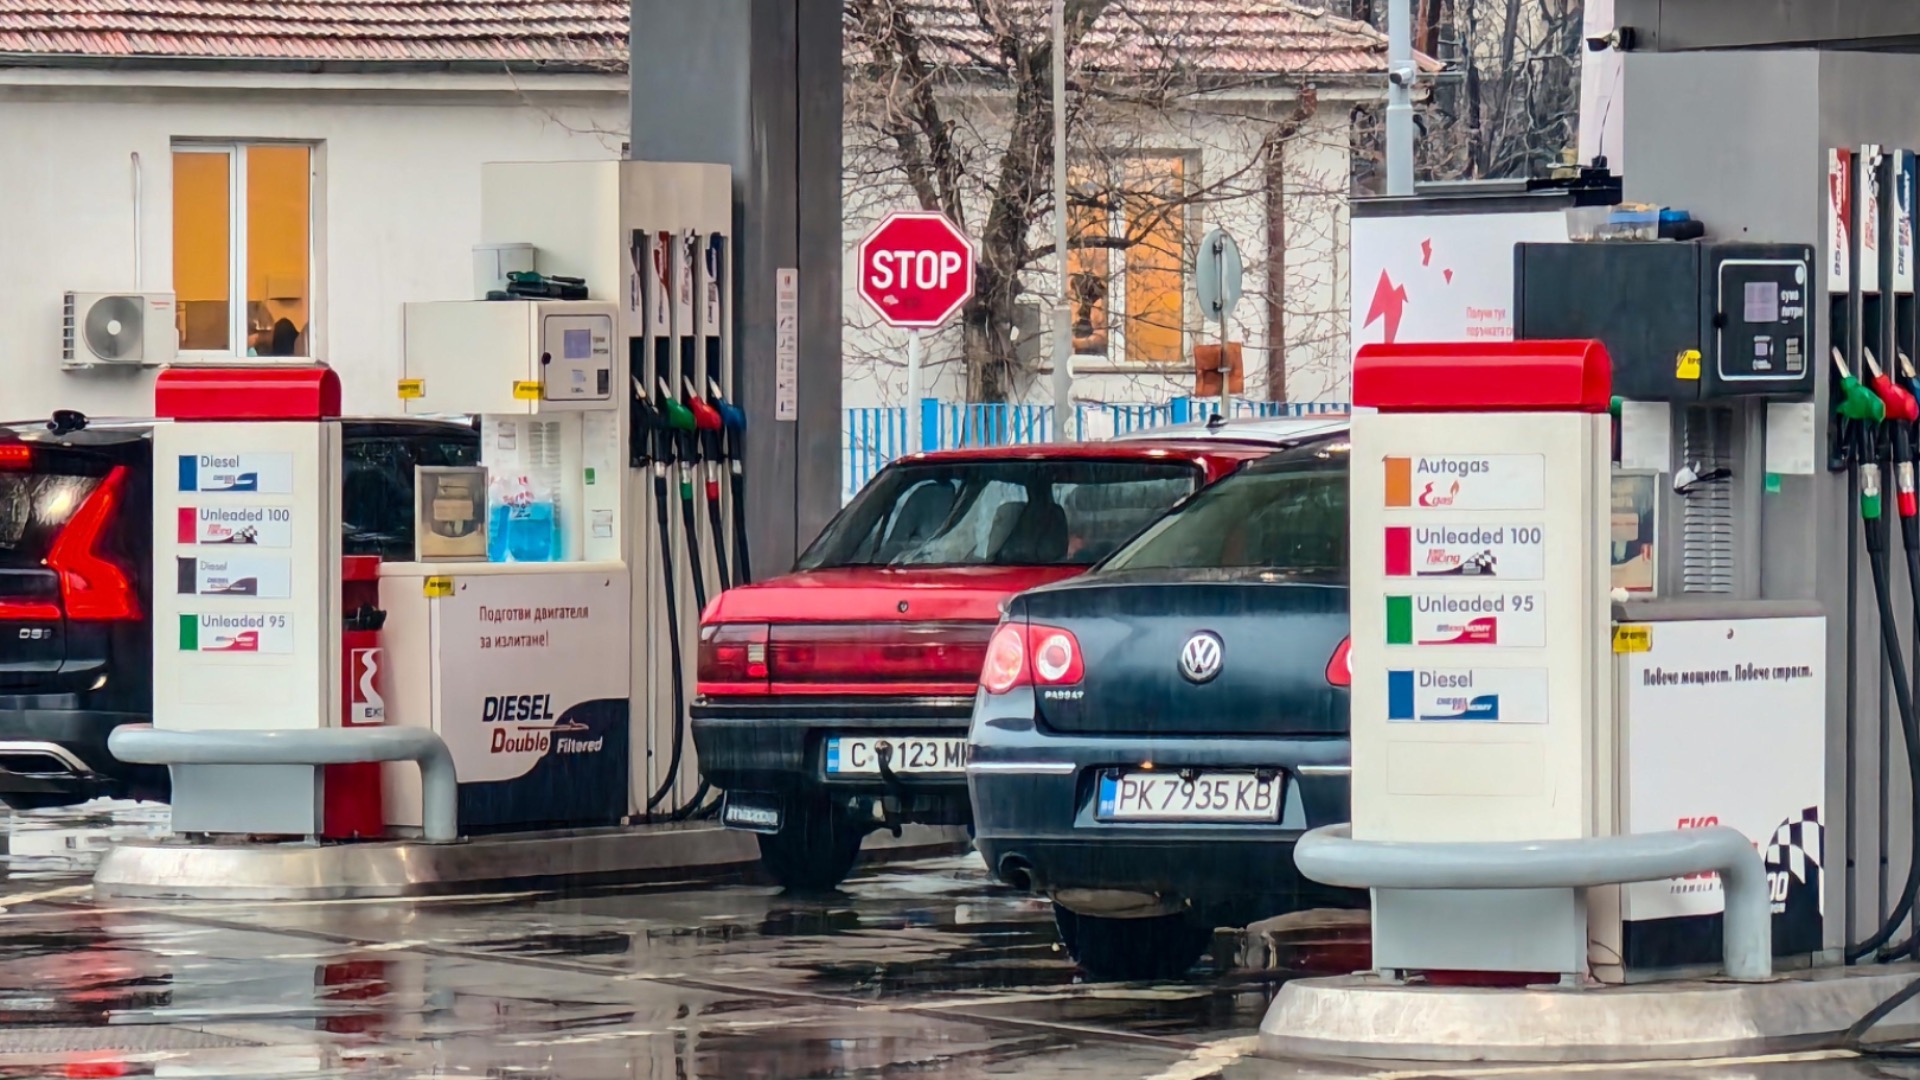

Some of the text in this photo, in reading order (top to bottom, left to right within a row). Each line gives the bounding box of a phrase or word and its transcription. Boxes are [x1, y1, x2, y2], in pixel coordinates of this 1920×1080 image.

[871, 249, 962, 290] STOP
[201, 455, 239, 468] Diesel
[1417, 458, 1489, 477] Autogas
[201, 508, 289, 521] Unleaded 100
[1416, 526, 1541, 544] Unleaded 100
[200, 561, 227, 571] Diesel
[1417, 594, 1533, 612] Unleaded 95
[202, 615, 285, 628] Unleaded 95
[480, 606, 589, 624] Подготви двигателя
[480, 630, 549, 648] за излитане!
[1420, 670, 1472, 687] Diesel
[1643, 666, 1679, 686] Повече
[1735, 662, 1769, 682] Повече
[482, 694, 554, 722] DIESEL
[491, 728, 603, 754] Double Filtered
[851, 742, 867, 767] C
[944, 741, 966, 767] M
[1119, 780, 1272, 810] PK 7935 KB
[1670, 883, 1713, 894] FORMULA
